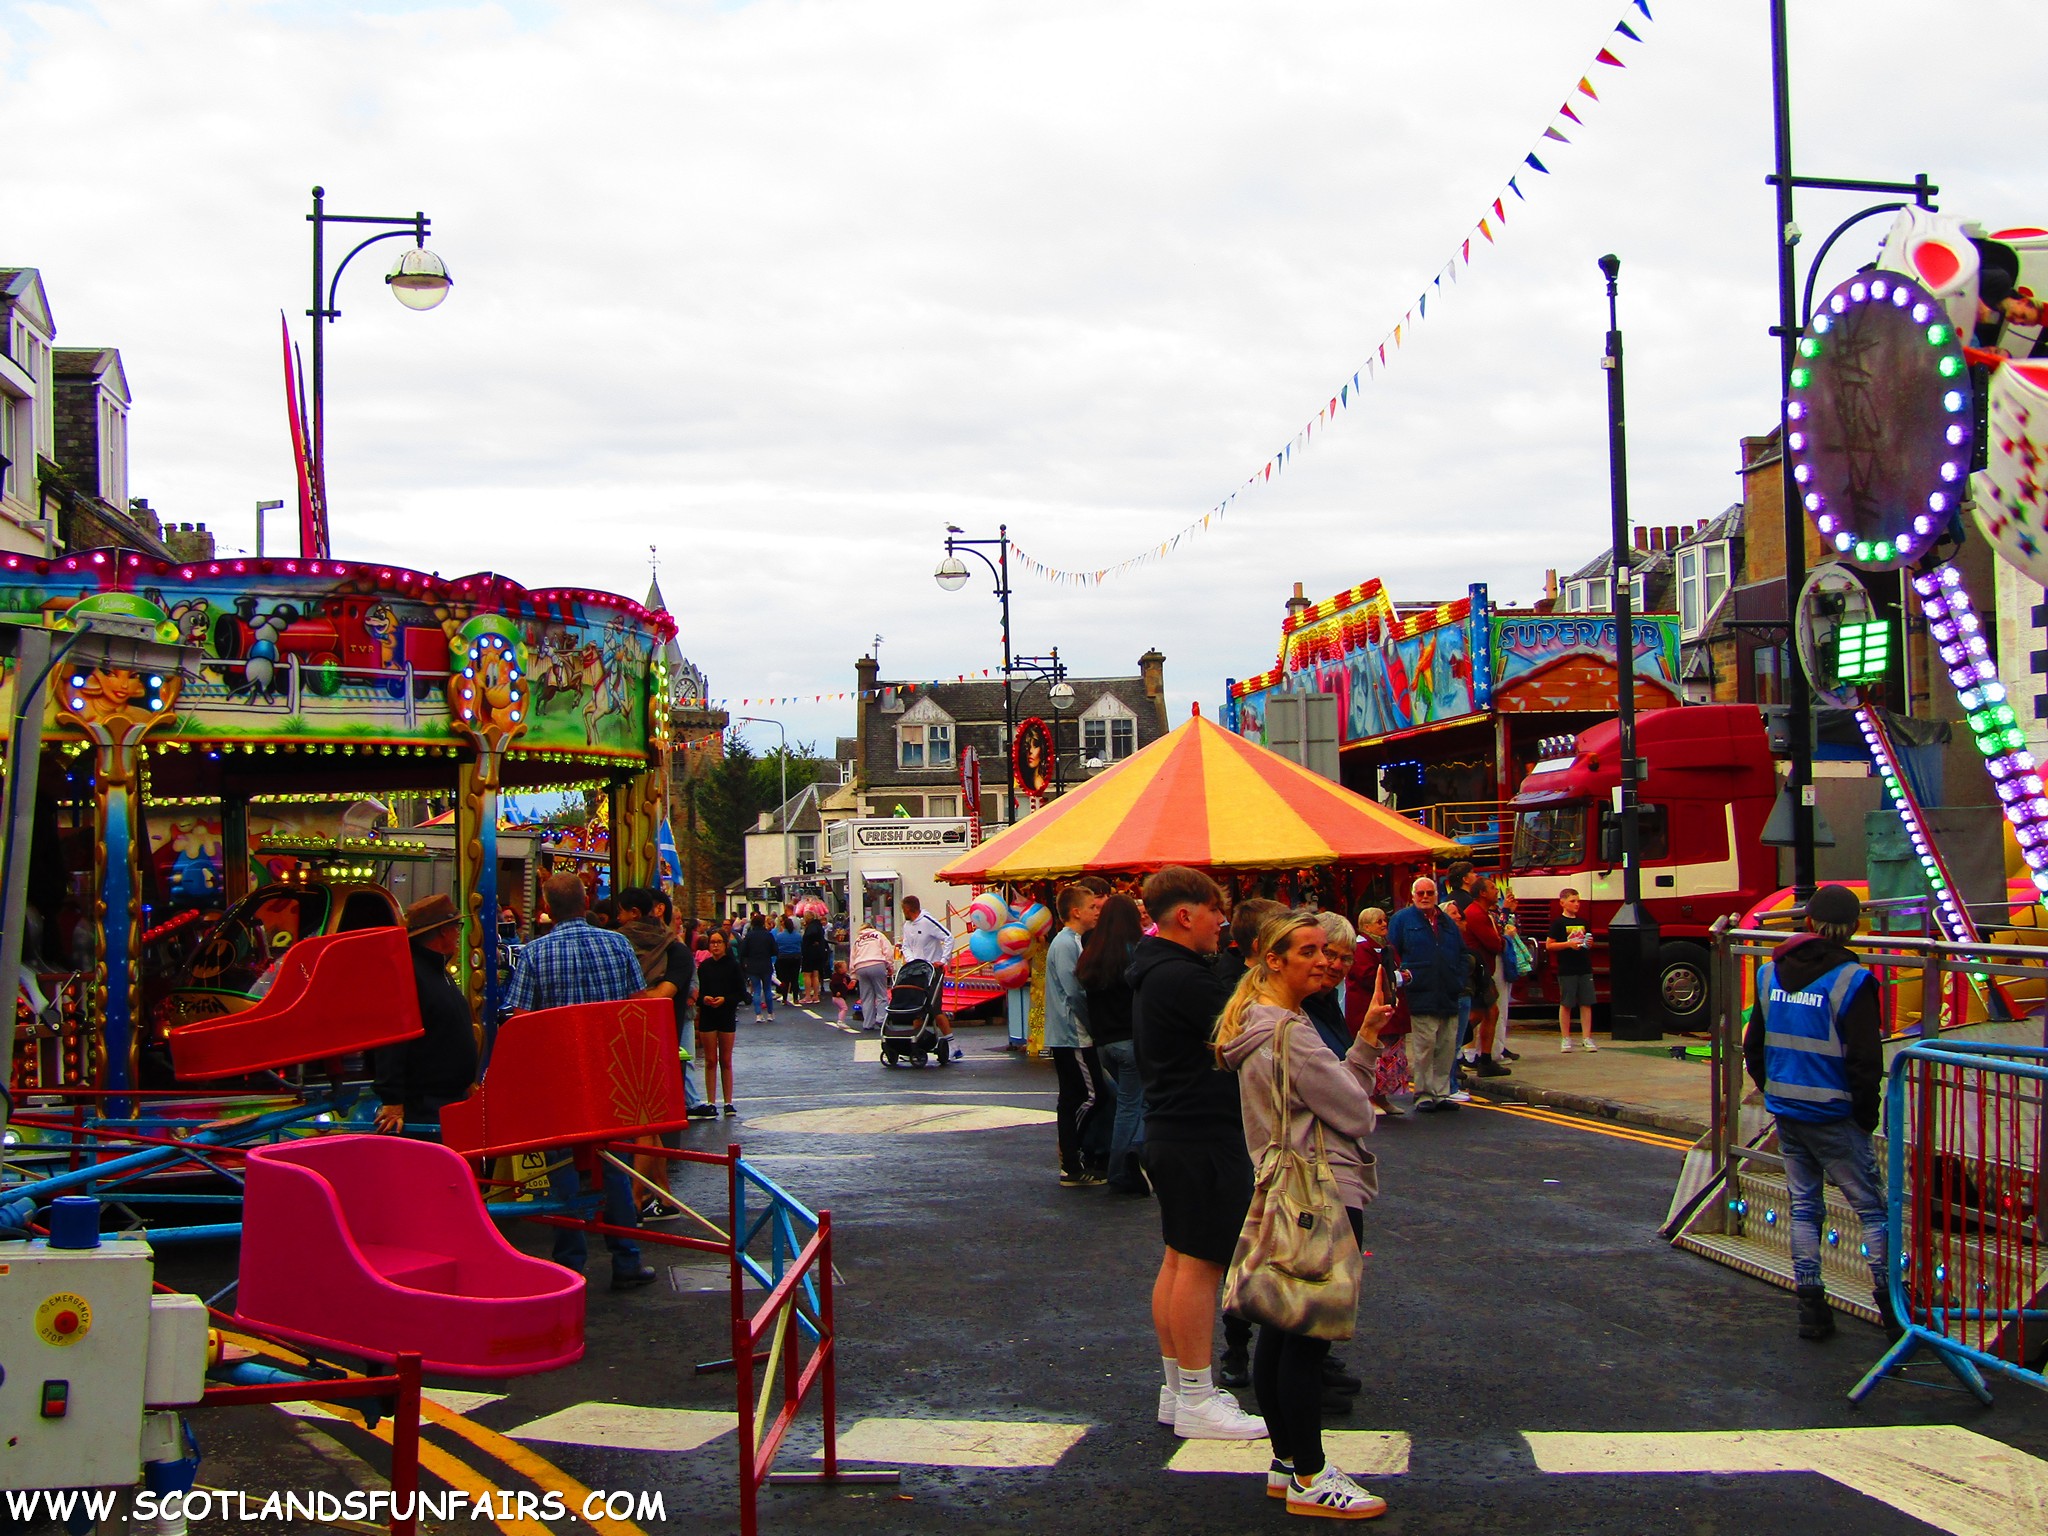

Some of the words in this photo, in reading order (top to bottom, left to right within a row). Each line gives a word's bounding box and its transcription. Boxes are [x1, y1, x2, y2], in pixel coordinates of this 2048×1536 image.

[1501, 622, 1598, 649] SUPER
[350, 644, 375, 653] TVR
[865, 831, 903, 842] FRESH
[906, 829, 942, 841] FOOD
[1769, 988, 1824, 1008] ATTENDANT
[525, 1180, 549, 1188] LOOR
[48, 1295, 89, 1323] EMERGENCY
[41, 1328, 64, 1343] STOP
